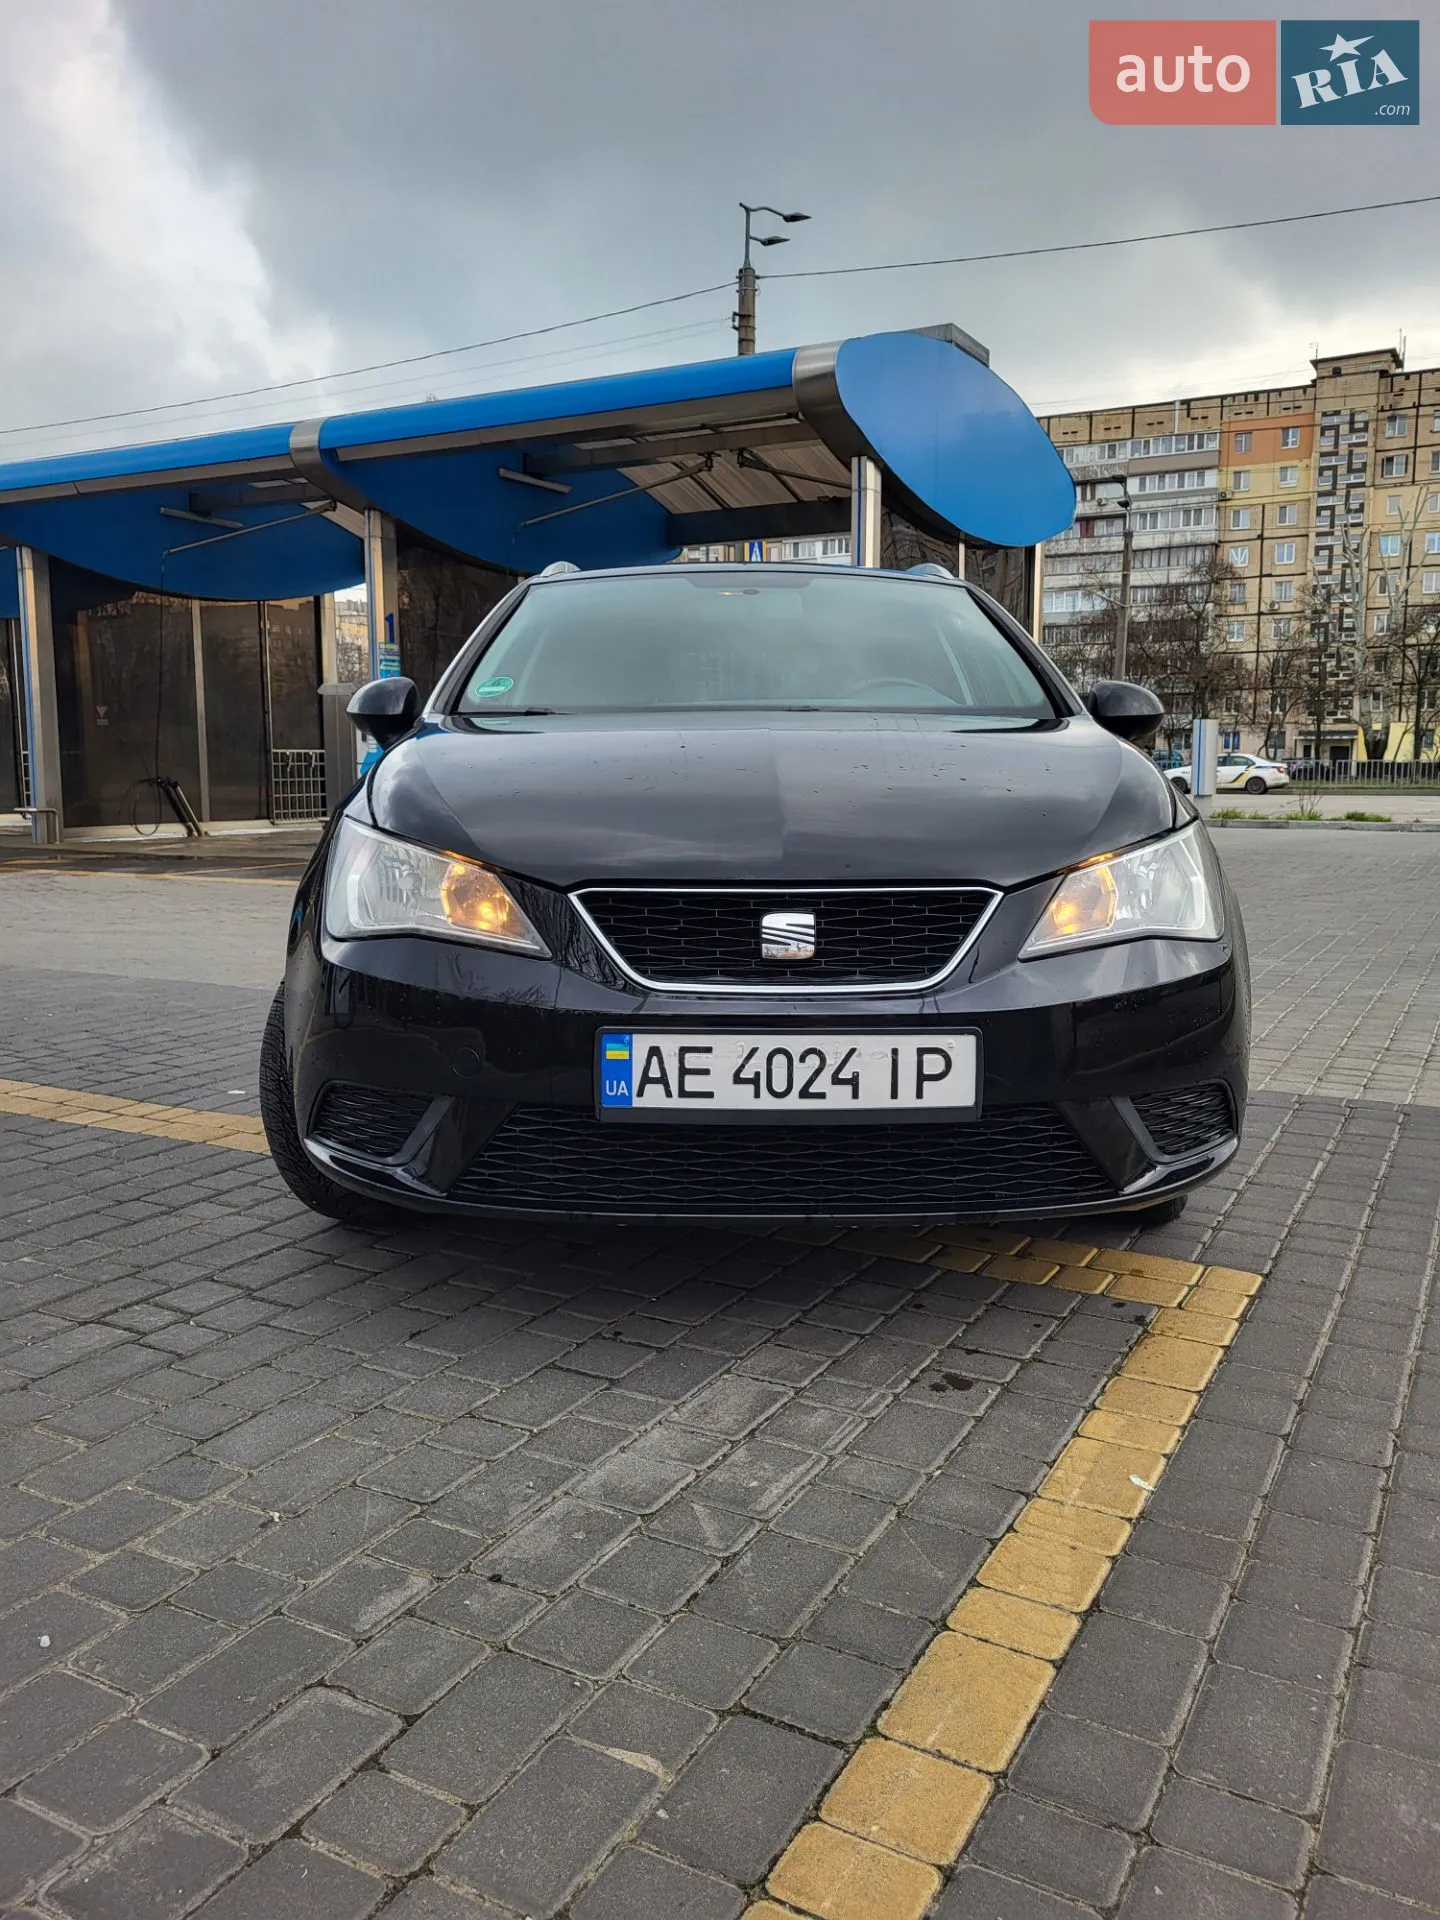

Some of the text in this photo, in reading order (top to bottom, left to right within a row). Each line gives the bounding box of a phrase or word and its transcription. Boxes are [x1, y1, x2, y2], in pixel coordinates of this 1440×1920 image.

[384, 612, 395, 643] 1
[605, 1079, 629, 1097] UA
[636, 1045, 953, 1100] AE 4024 IP
